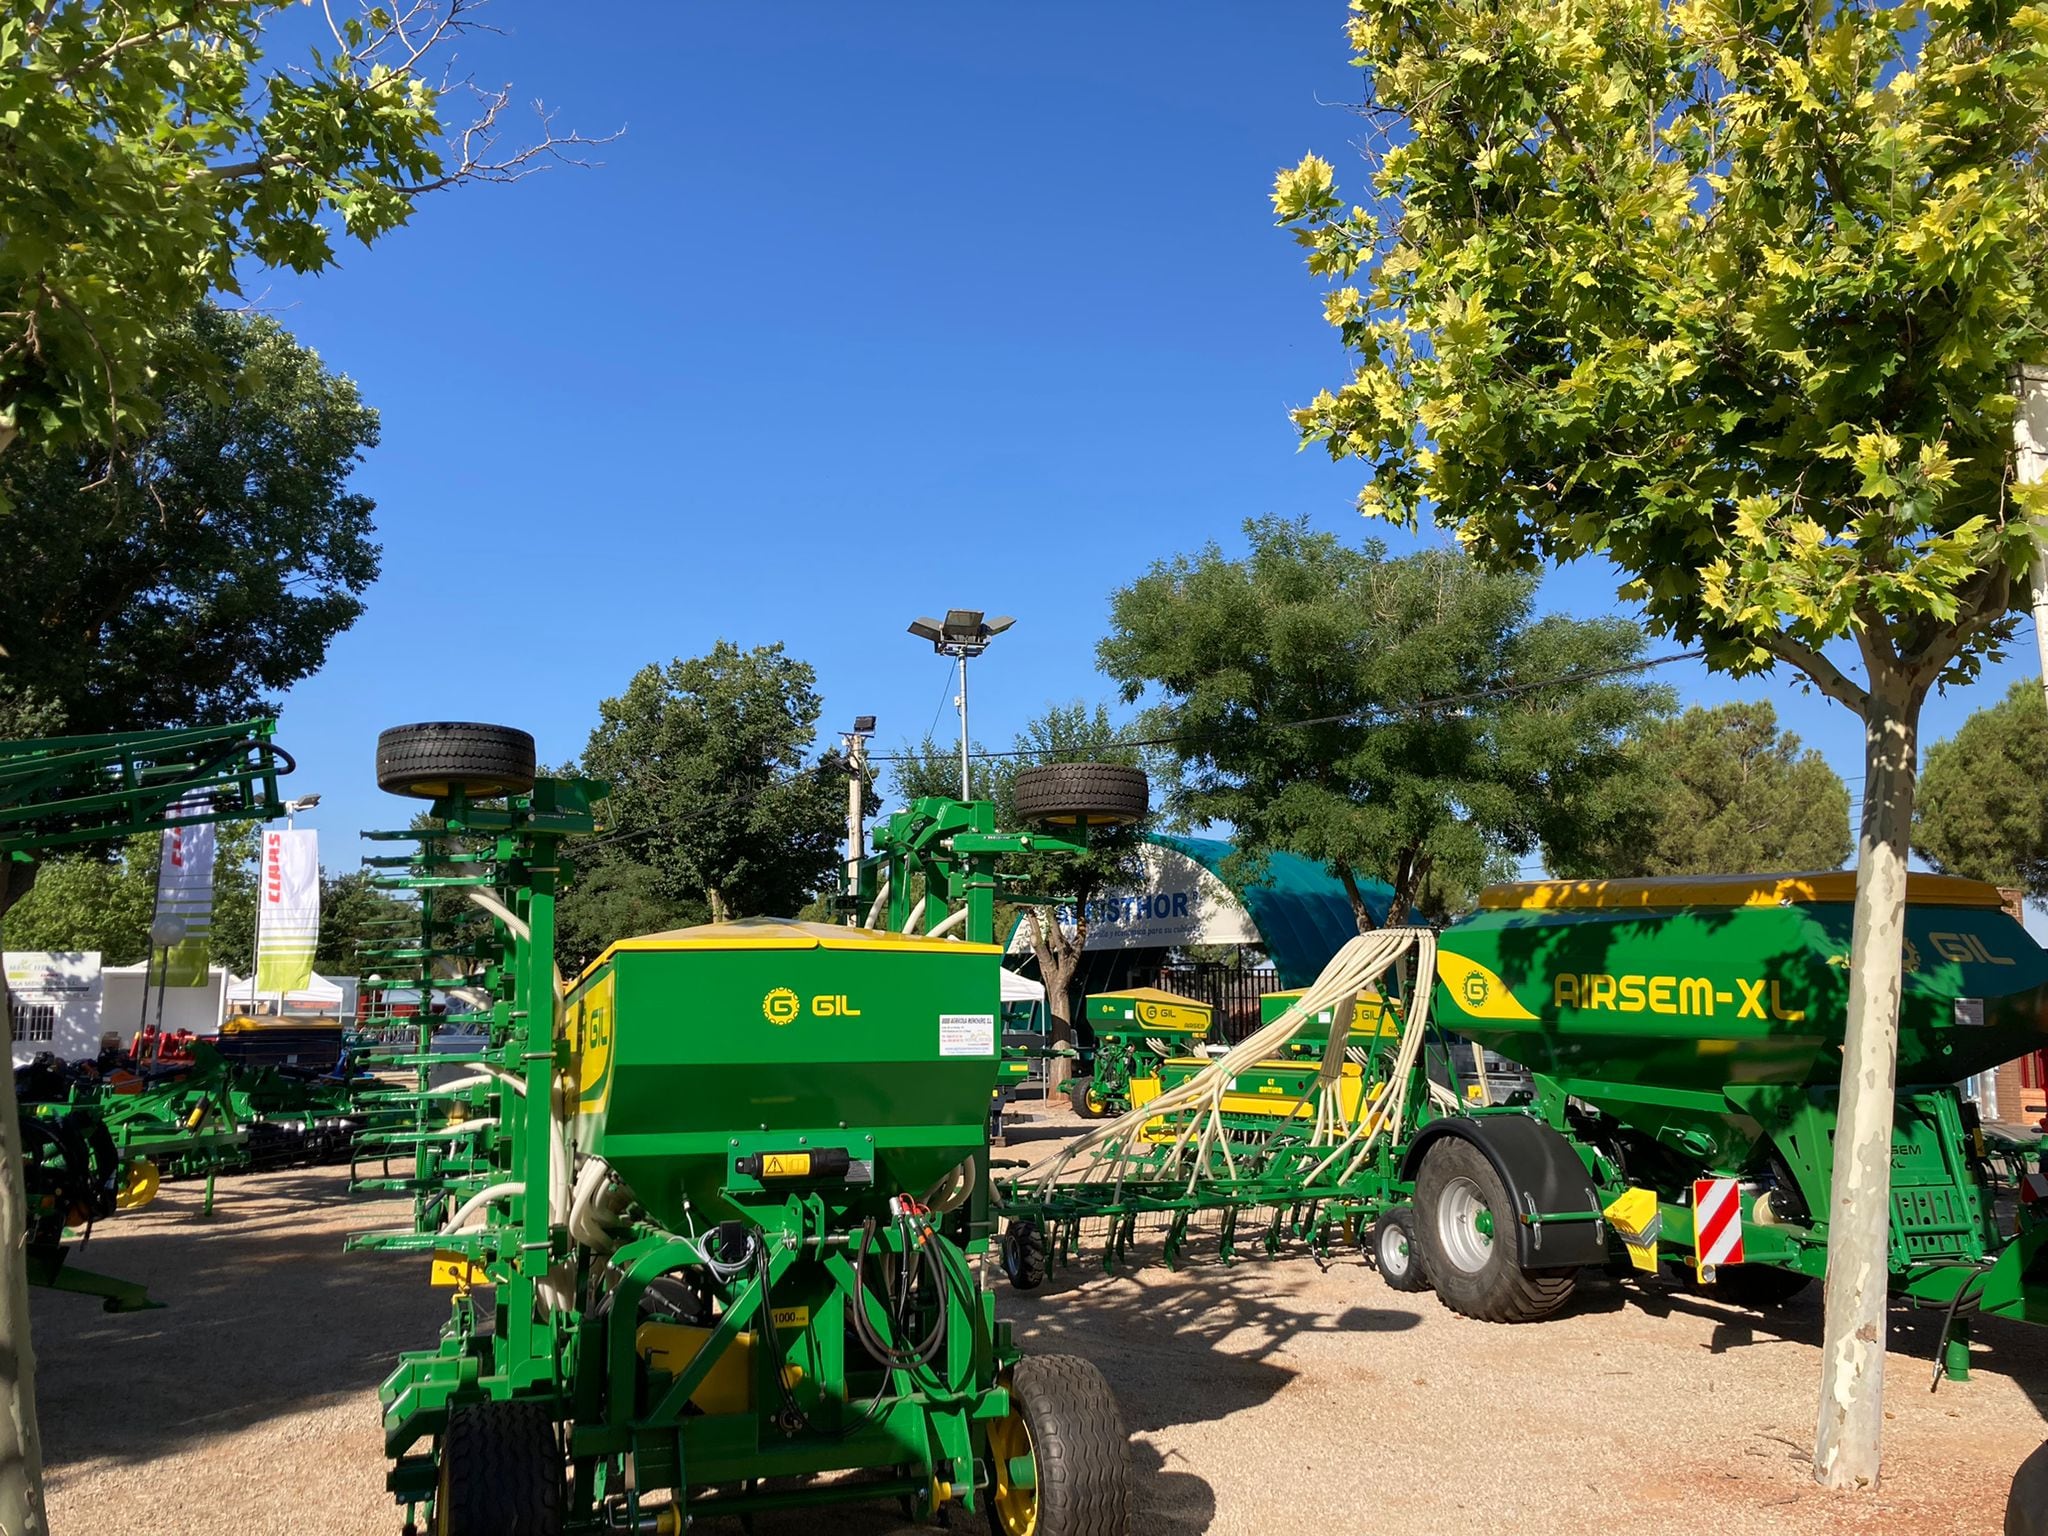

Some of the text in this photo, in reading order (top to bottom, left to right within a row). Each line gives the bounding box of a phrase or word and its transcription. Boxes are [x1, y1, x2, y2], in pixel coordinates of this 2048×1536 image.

[268, 833, 281, 903] CLAAS
[1147, 927, 1163, 936] para
[1928, 932, 2016, 966] GIL
[1554, 973, 1805, 1021] AIRSEM-XL
[812, 995, 861, 1016] GIL
[1161, 1009, 1176, 1018] GIL
[1361, 1010, 1380, 1020] GIL
[590, 1007, 608, 1049] GIL
[1891, 1144, 1922, 1155] SEM
[774, 1311, 796, 1323] 1000
